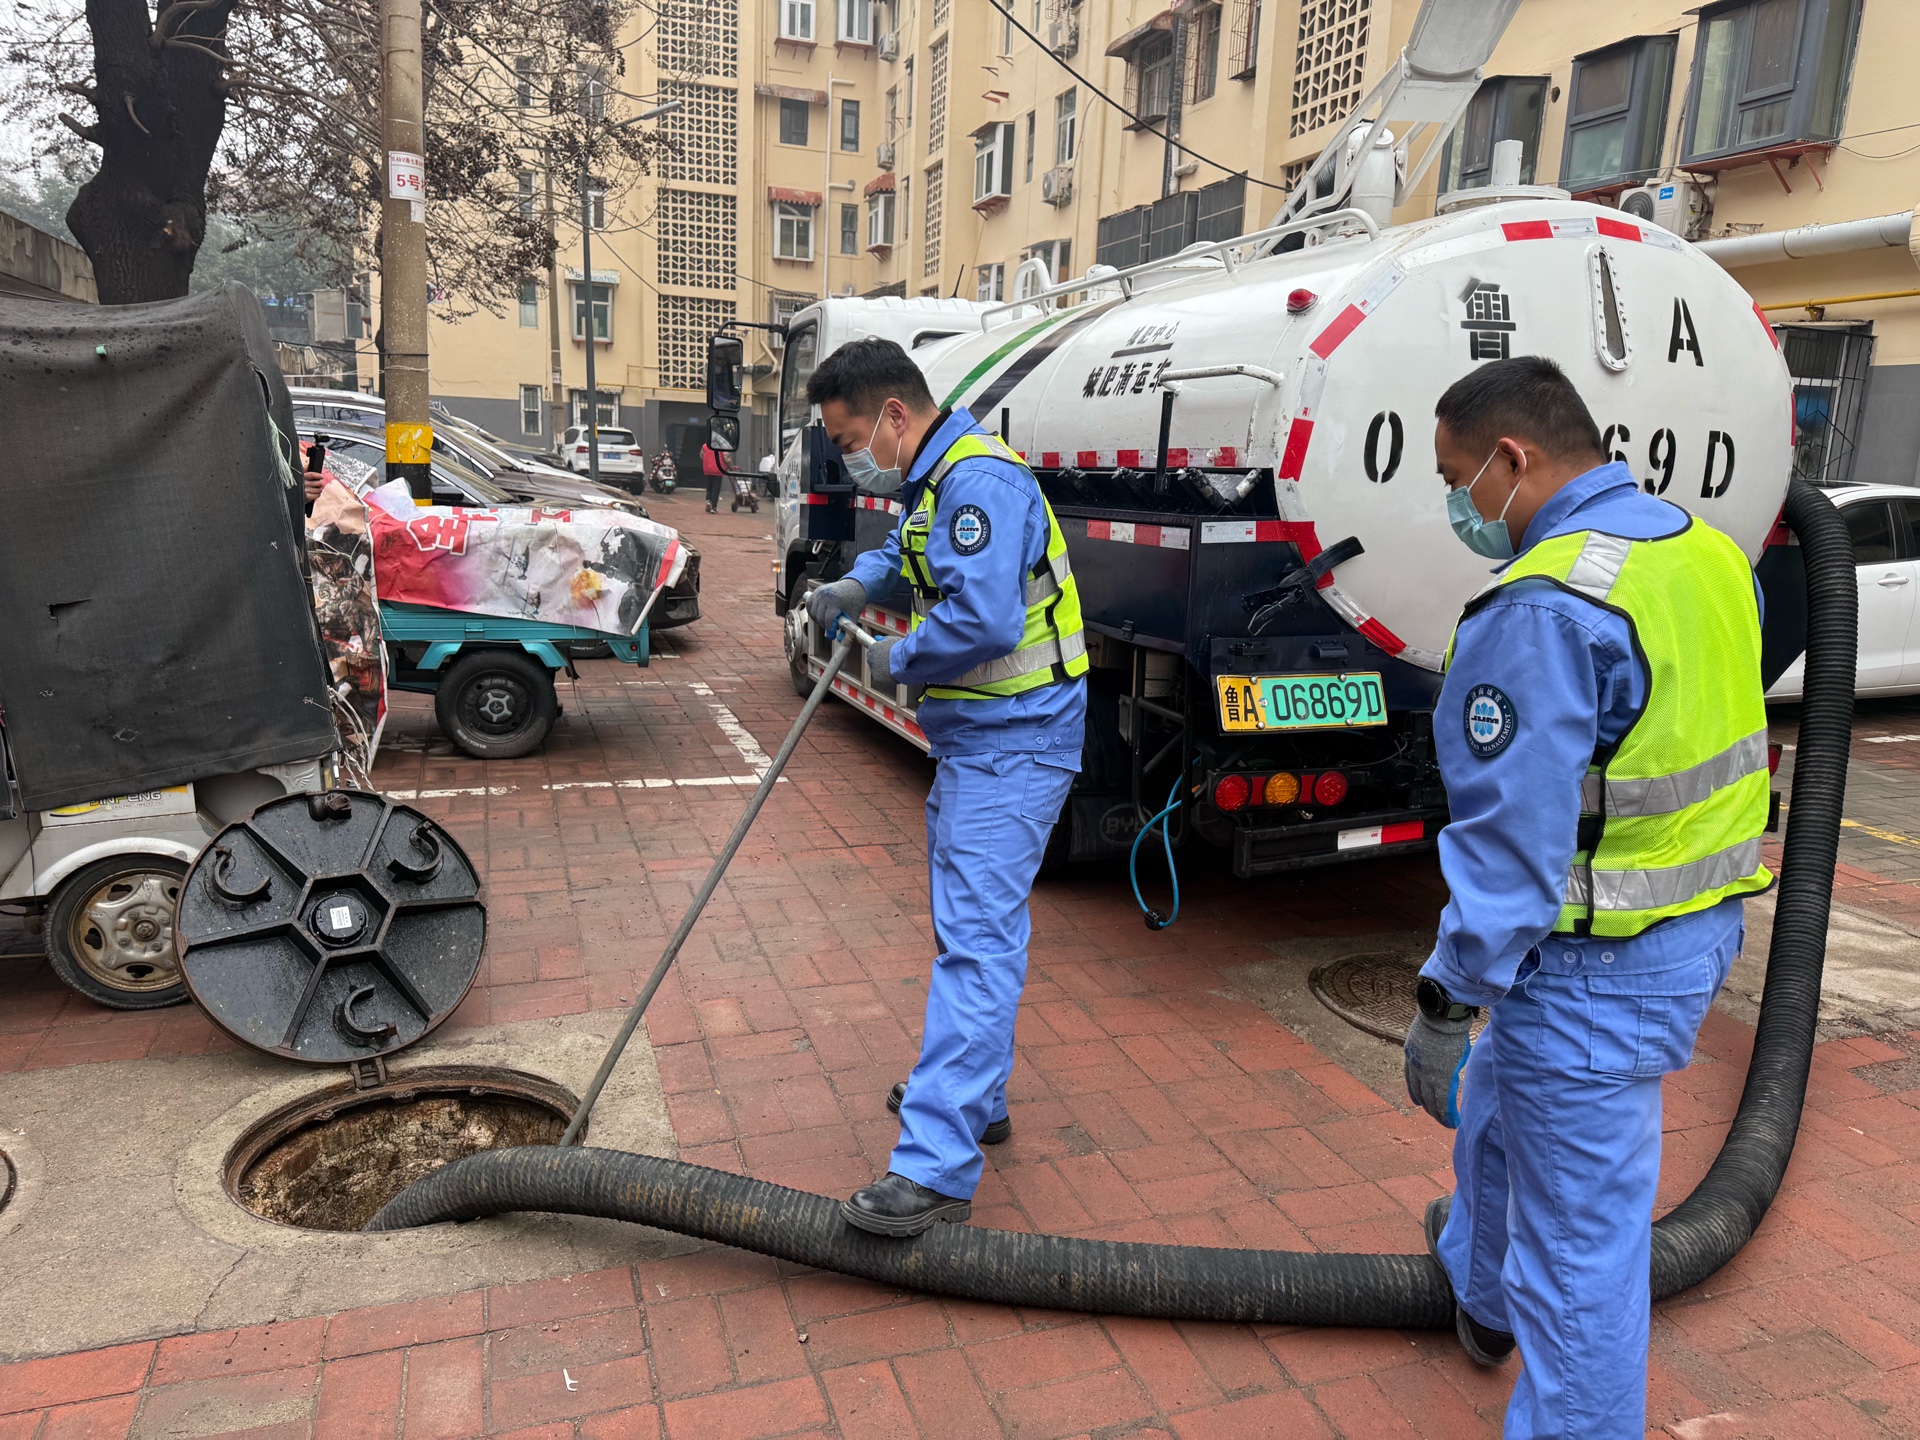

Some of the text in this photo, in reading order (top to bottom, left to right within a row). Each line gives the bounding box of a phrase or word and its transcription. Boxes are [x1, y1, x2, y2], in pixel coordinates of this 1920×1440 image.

[1668, 296, 1704, 367] A
[1082, 357, 1173, 399] 城肥清运车
[1224, 681, 1382, 722] 鲁A 06869D
[1482, 713, 1512, 753] MANAGEMENT
